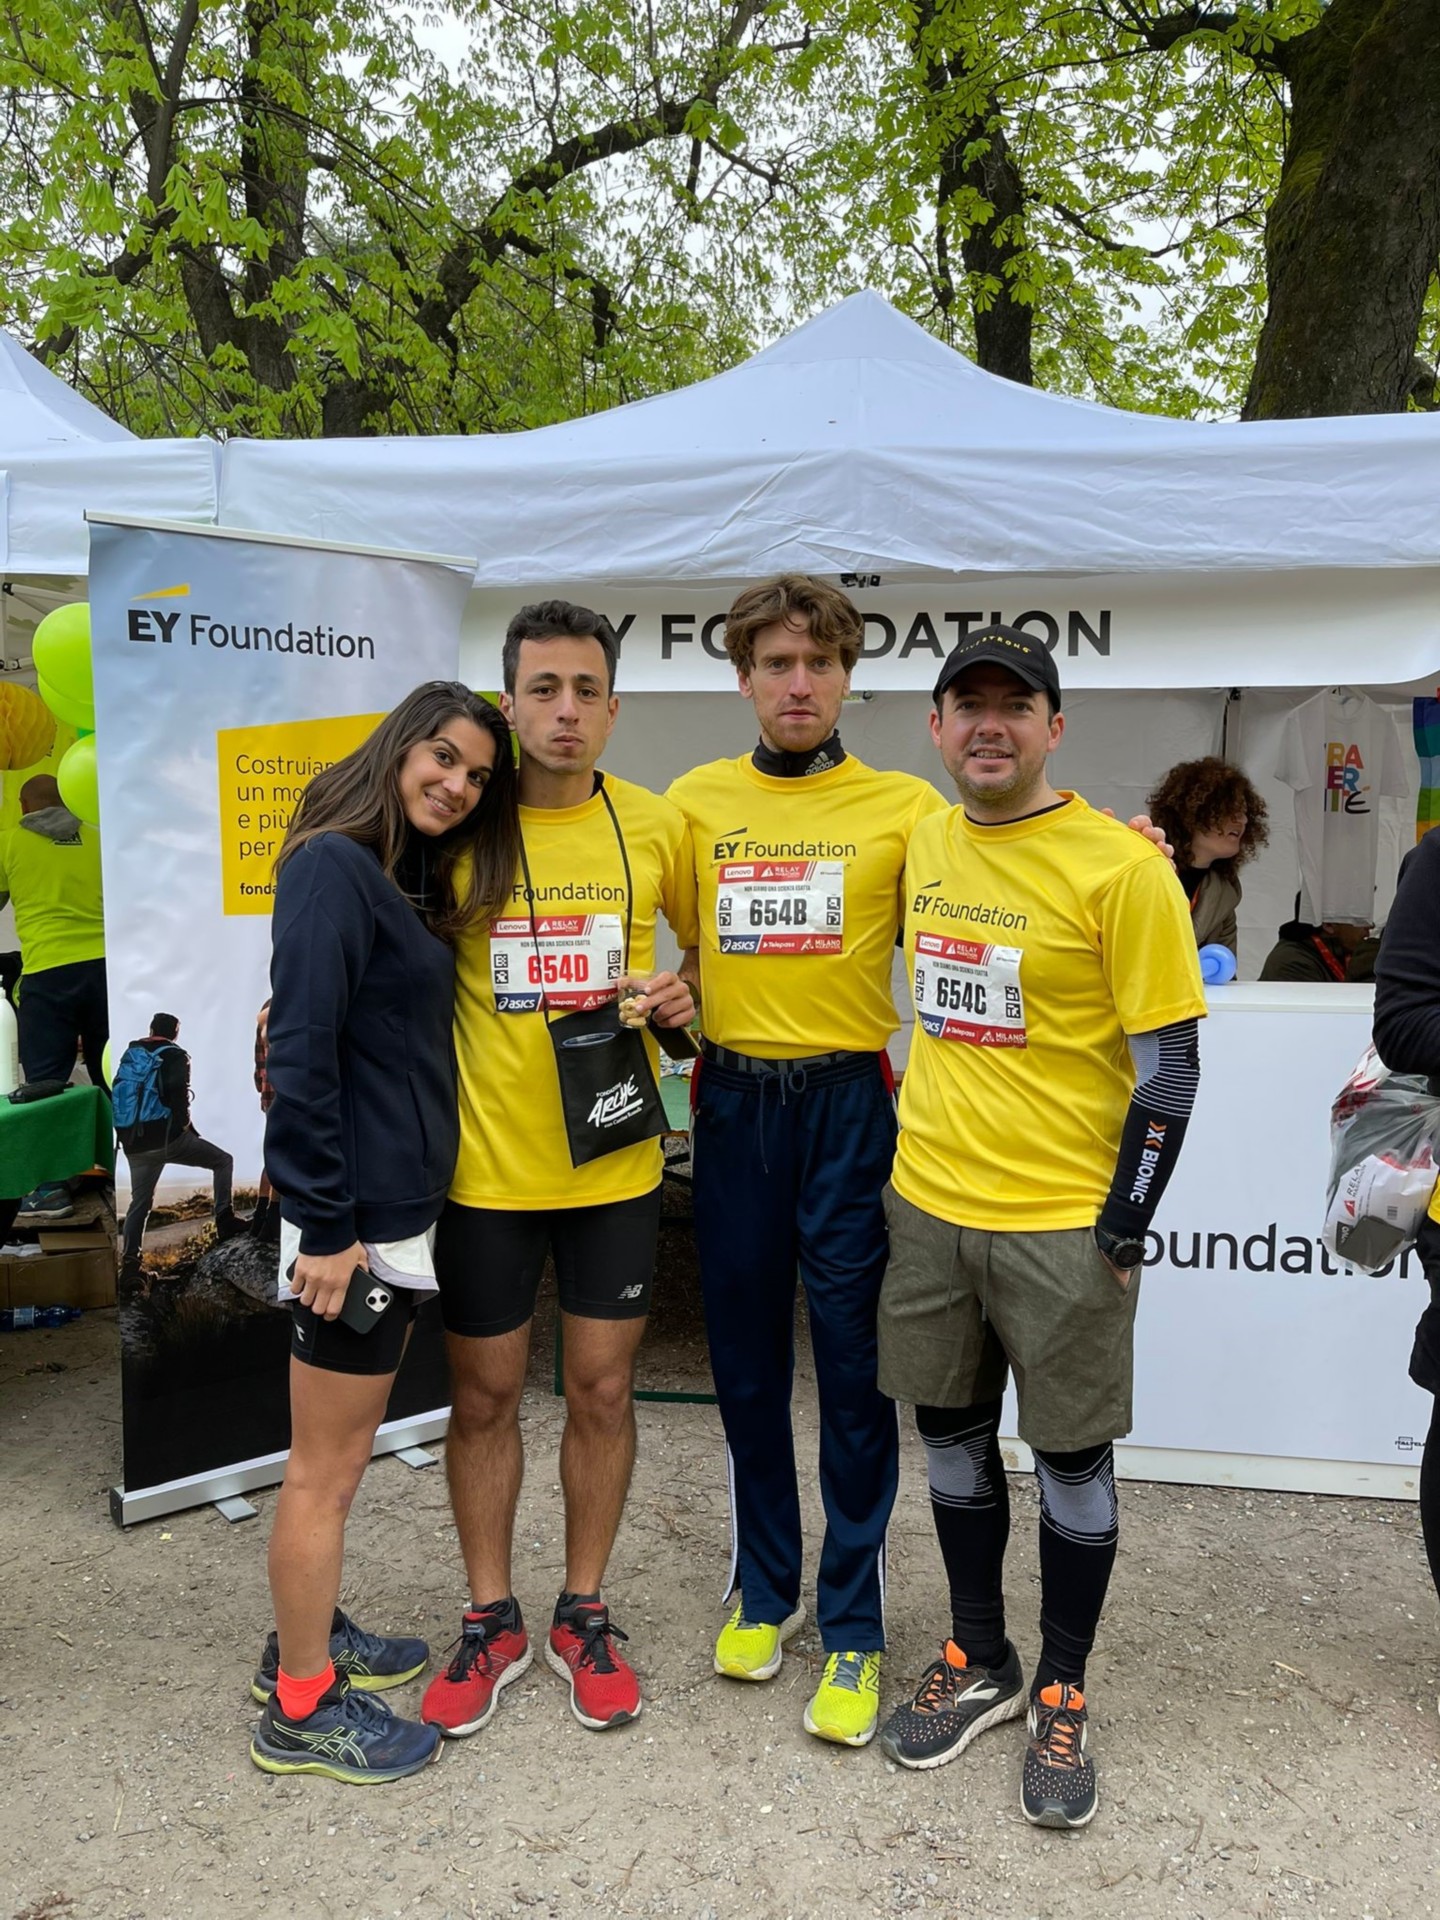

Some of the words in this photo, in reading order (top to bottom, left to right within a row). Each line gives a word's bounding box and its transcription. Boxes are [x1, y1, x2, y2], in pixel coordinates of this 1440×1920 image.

[128, 609, 181, 643] EY
[190, 614, 375, 660] Foundation
[604, 613, 637, 660] Y
[661, 610, 1112, 660] FODATON
[805, 760, 834, 776] adidas
[237, 786, 264, 801] un
[273, 786, 304, 802] mo
[238, 813, 251, 829] e
[259, 809, 291, 833] più
[239, 840, 275, 860] per
[714, 842, 740, 860] EY
[744, 840, 856, 858] Foundation
[240, 882, 277, 895] fonda
[512, 882, 625, 903] Foundation
[750, 898, 807, 927] 654B
[913, 894, 933, 914] EY
[931, 898, 1028, 931] Foundation
[499, 922, 527, 931] Lenovo
[921, 939, 940, 949] Lenovo
[956, 944, 978, 953] RELAY
[528, 954, 589, 984] 654D
[936, 977, 987, 1016] 654C
[1129, 1148, 1160, 1204] BIONIC
[1142, 1222, 1429, 1280] oundatn
